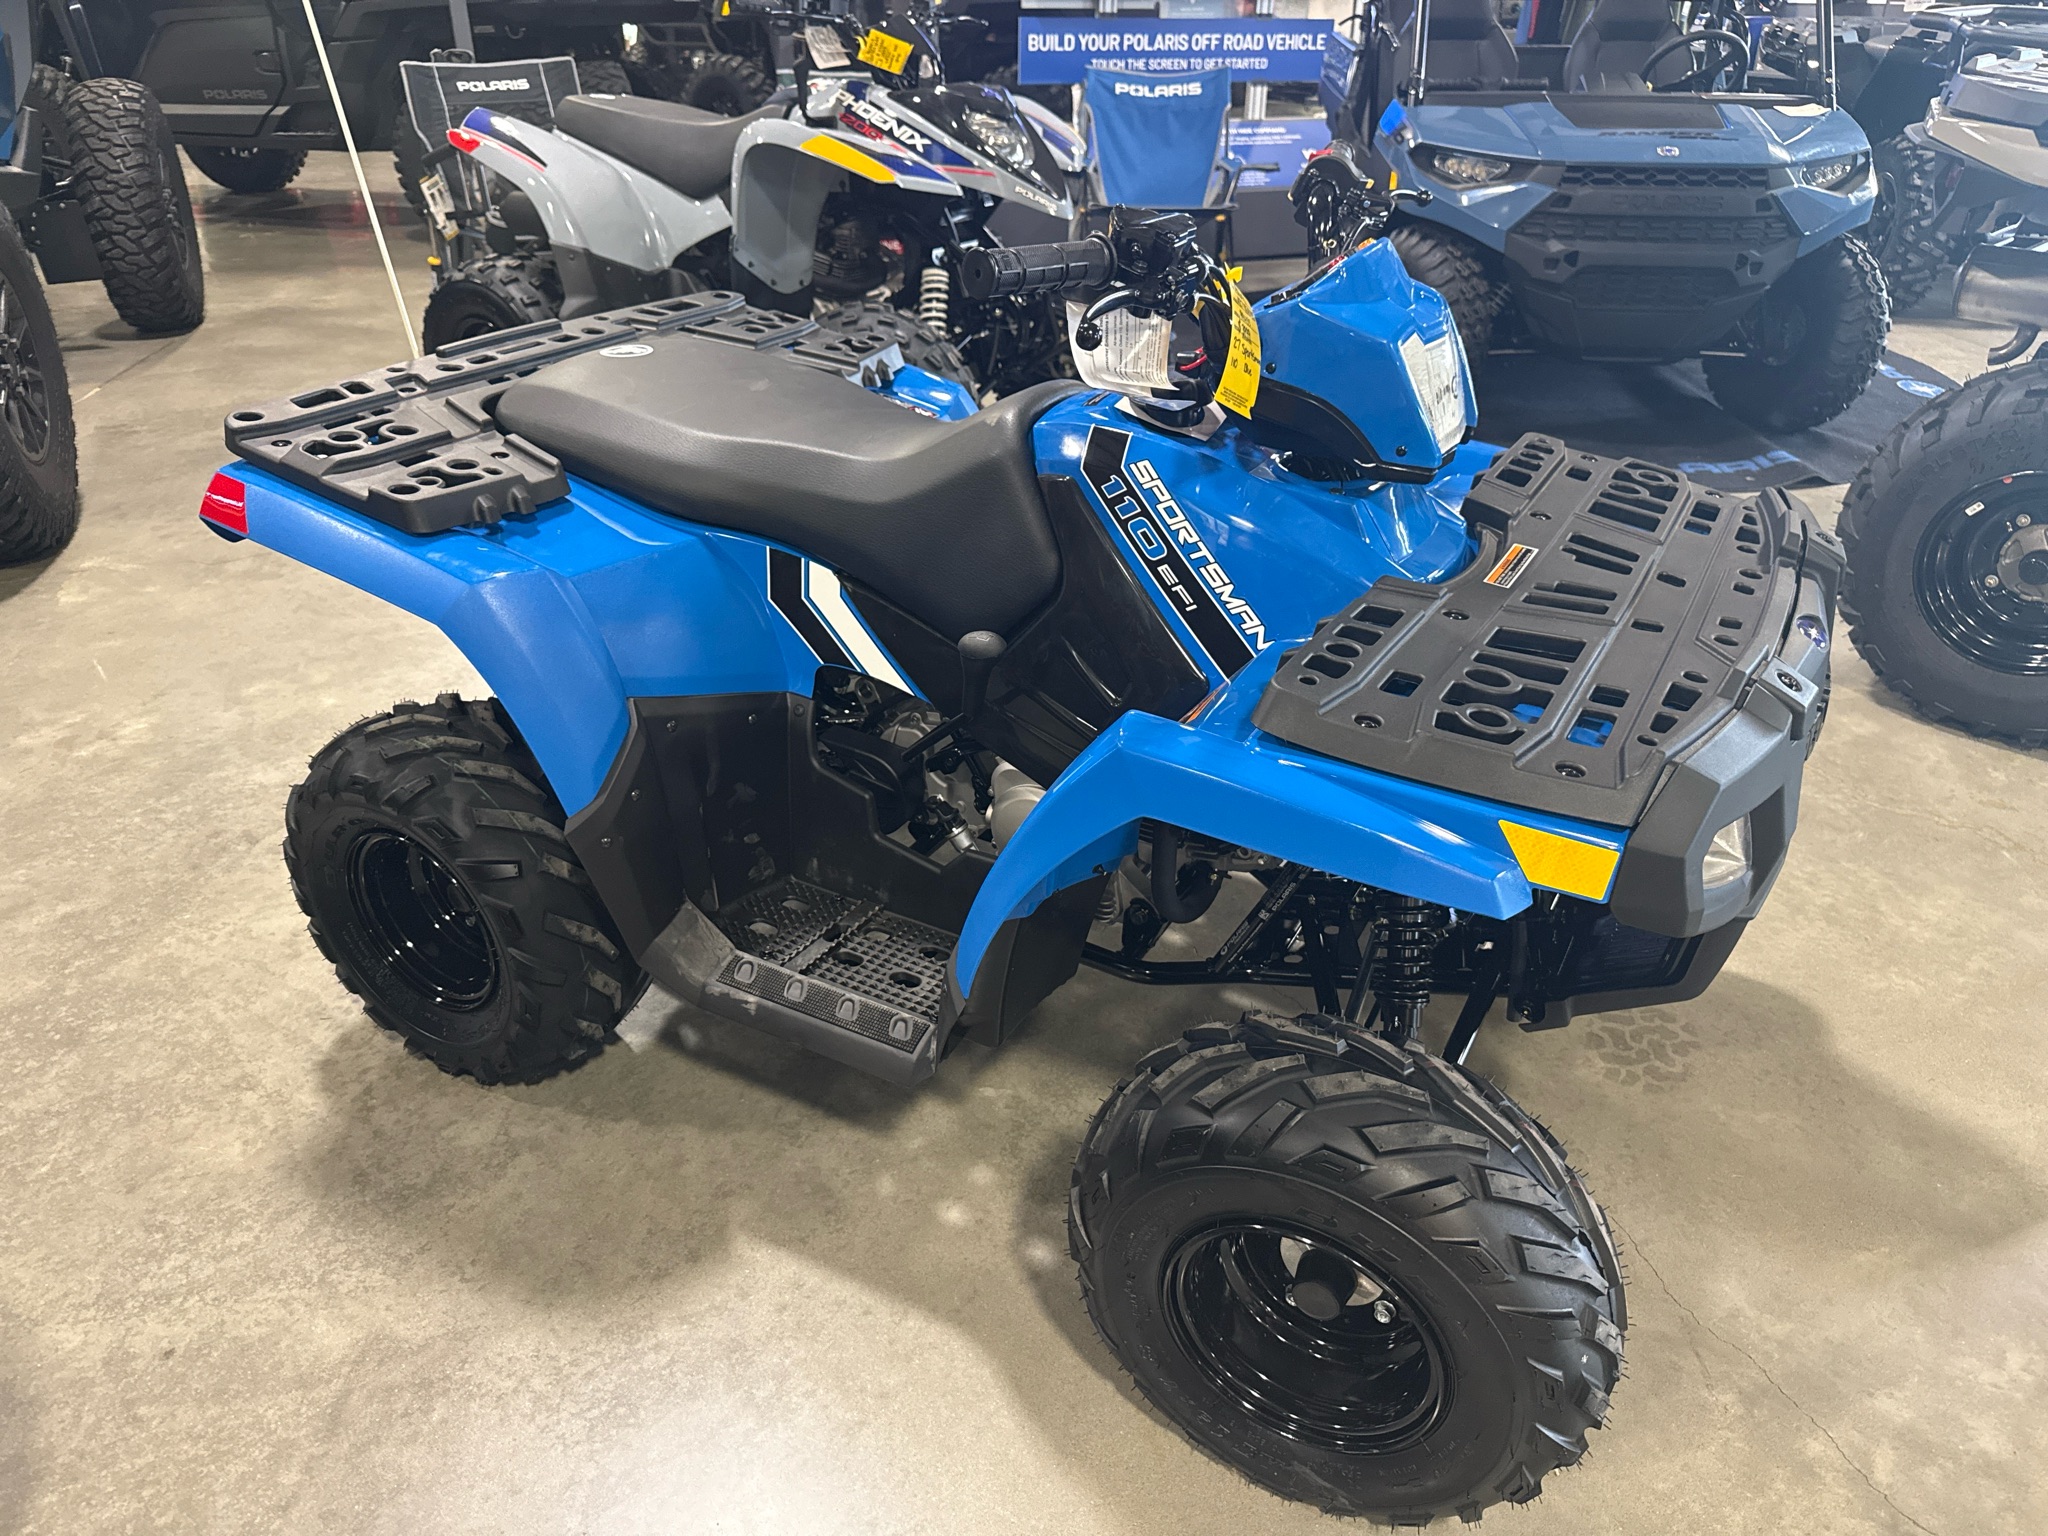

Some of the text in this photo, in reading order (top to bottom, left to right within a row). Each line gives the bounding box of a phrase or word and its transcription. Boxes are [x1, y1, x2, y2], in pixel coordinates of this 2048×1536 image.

[1027, 33, 1327, 52] BUILD YOUR POLARIS OFF ROAD VEHICLE
[1091, 58, 1269, 70] TOUCH THE SCREEN TO GET STARTED
[202, 88, 268, 101] POLARIS
[456, 78, 530, 93] POLARIS
[1115, 82, 1203, 98] POLARIS
[833, 89, 932, 153] PHOENIX
[838, 112, 884, 141] 200
[1014, 186, 1058, 212] POLARIS
[1101, 474, 1198, 612] 110 EFI
[1129, 459, 1276, 651] SPORTSMAN
[1271, 881, 1297, 911] POLARIS
